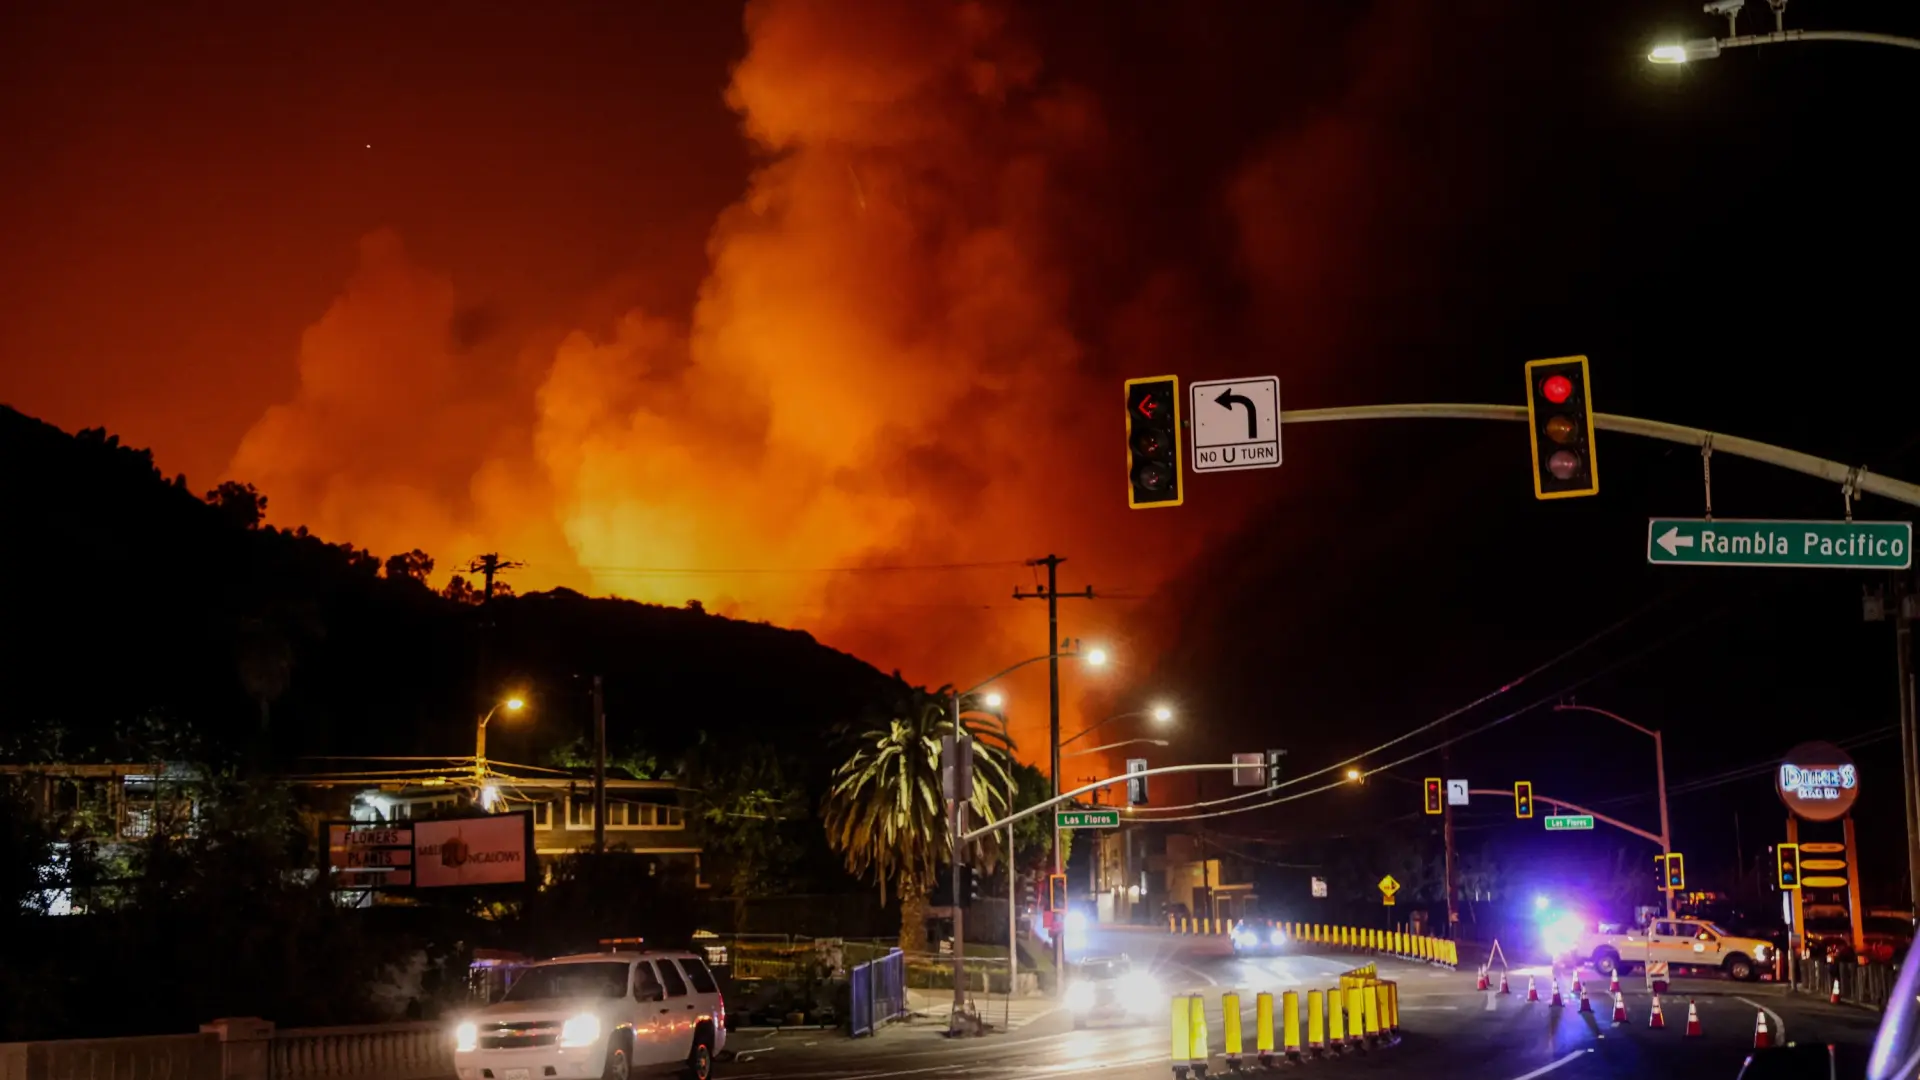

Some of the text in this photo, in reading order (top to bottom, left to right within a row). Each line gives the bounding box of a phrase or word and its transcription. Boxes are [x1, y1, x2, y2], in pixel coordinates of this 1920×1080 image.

[1200, 447, 1274, 463] NO U TURN
[1701, 531, 1904, 557] Rambla Pacifico
[1064, 814, 1111, 825] Las Flores
[1551, 819, 1587, 827] Las Flores
[344, 830, 398, 845] FLOWERS
[348, 851, 392, 867] PLANTS
